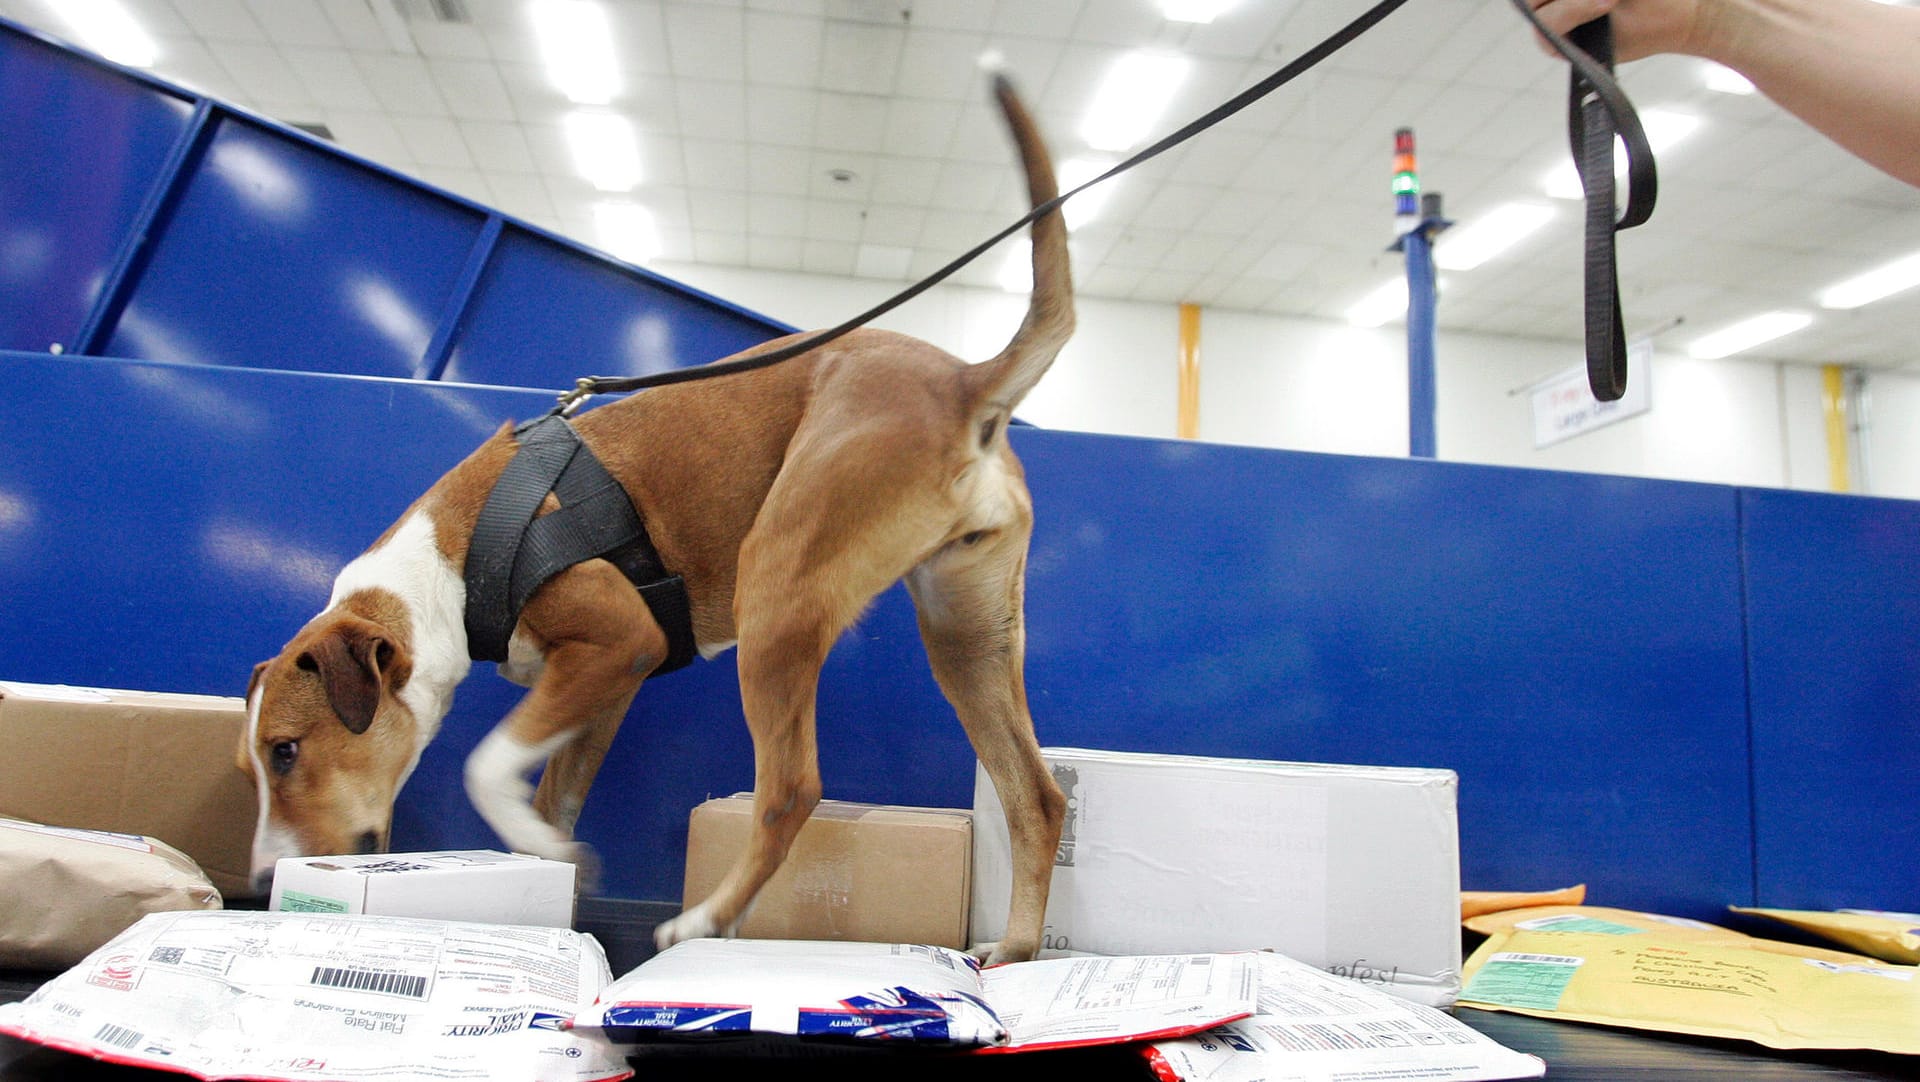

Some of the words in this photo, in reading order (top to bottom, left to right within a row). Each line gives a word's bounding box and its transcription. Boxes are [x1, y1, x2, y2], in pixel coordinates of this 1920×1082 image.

[1634, 975, 1740, 990] AUSTRALIA
[462, 1005, 495, 1013] SERVICE
[655, 1012, 678, 1020] MAIL
[344, 1016, 377, 1032] Rate
[488, 1012, 529, 1026] MAIL
[381, 1020, 405, 1035] Flat
[446, 1022, 522, 1038] PRIORITY
